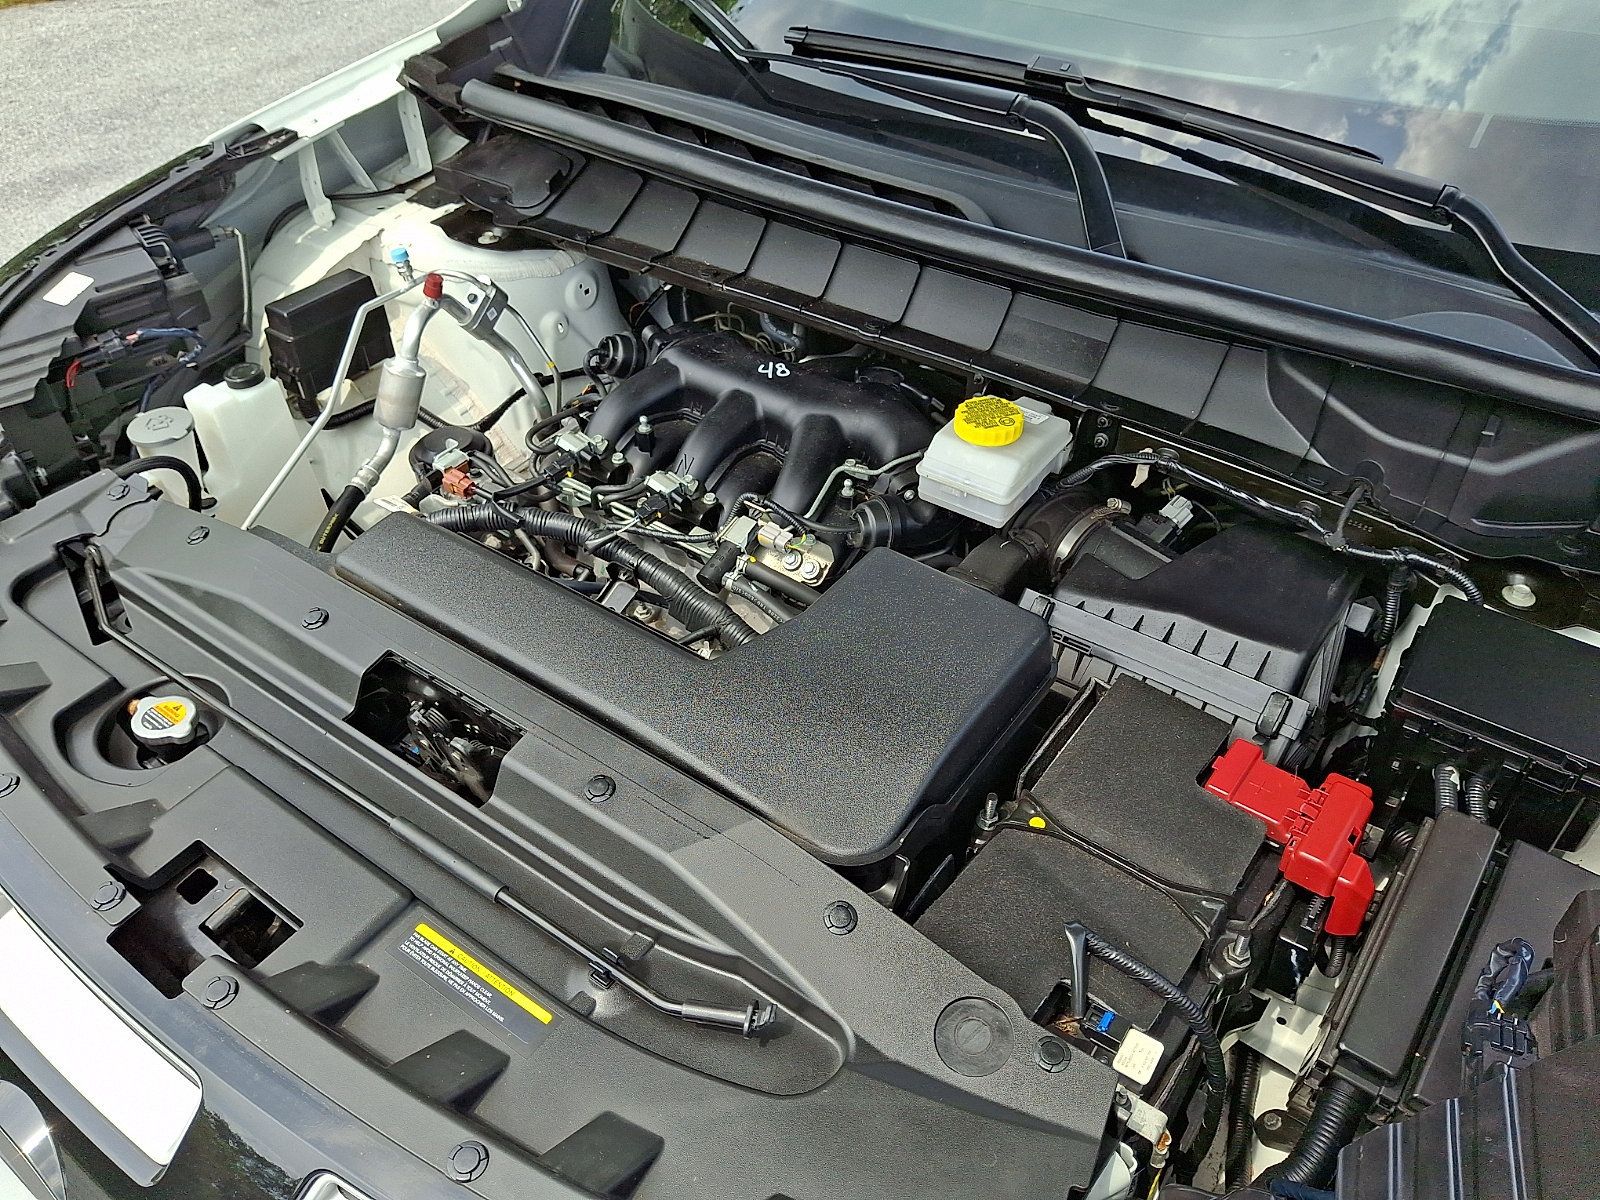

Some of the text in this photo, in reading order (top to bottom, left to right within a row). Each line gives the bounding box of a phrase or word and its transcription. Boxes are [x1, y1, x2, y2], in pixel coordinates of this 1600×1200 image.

[757, 361, 791, 379] 48
[399, 943, 411, 954] POUR
[456, 952, 514, 996] CAUTION ATTENTION
